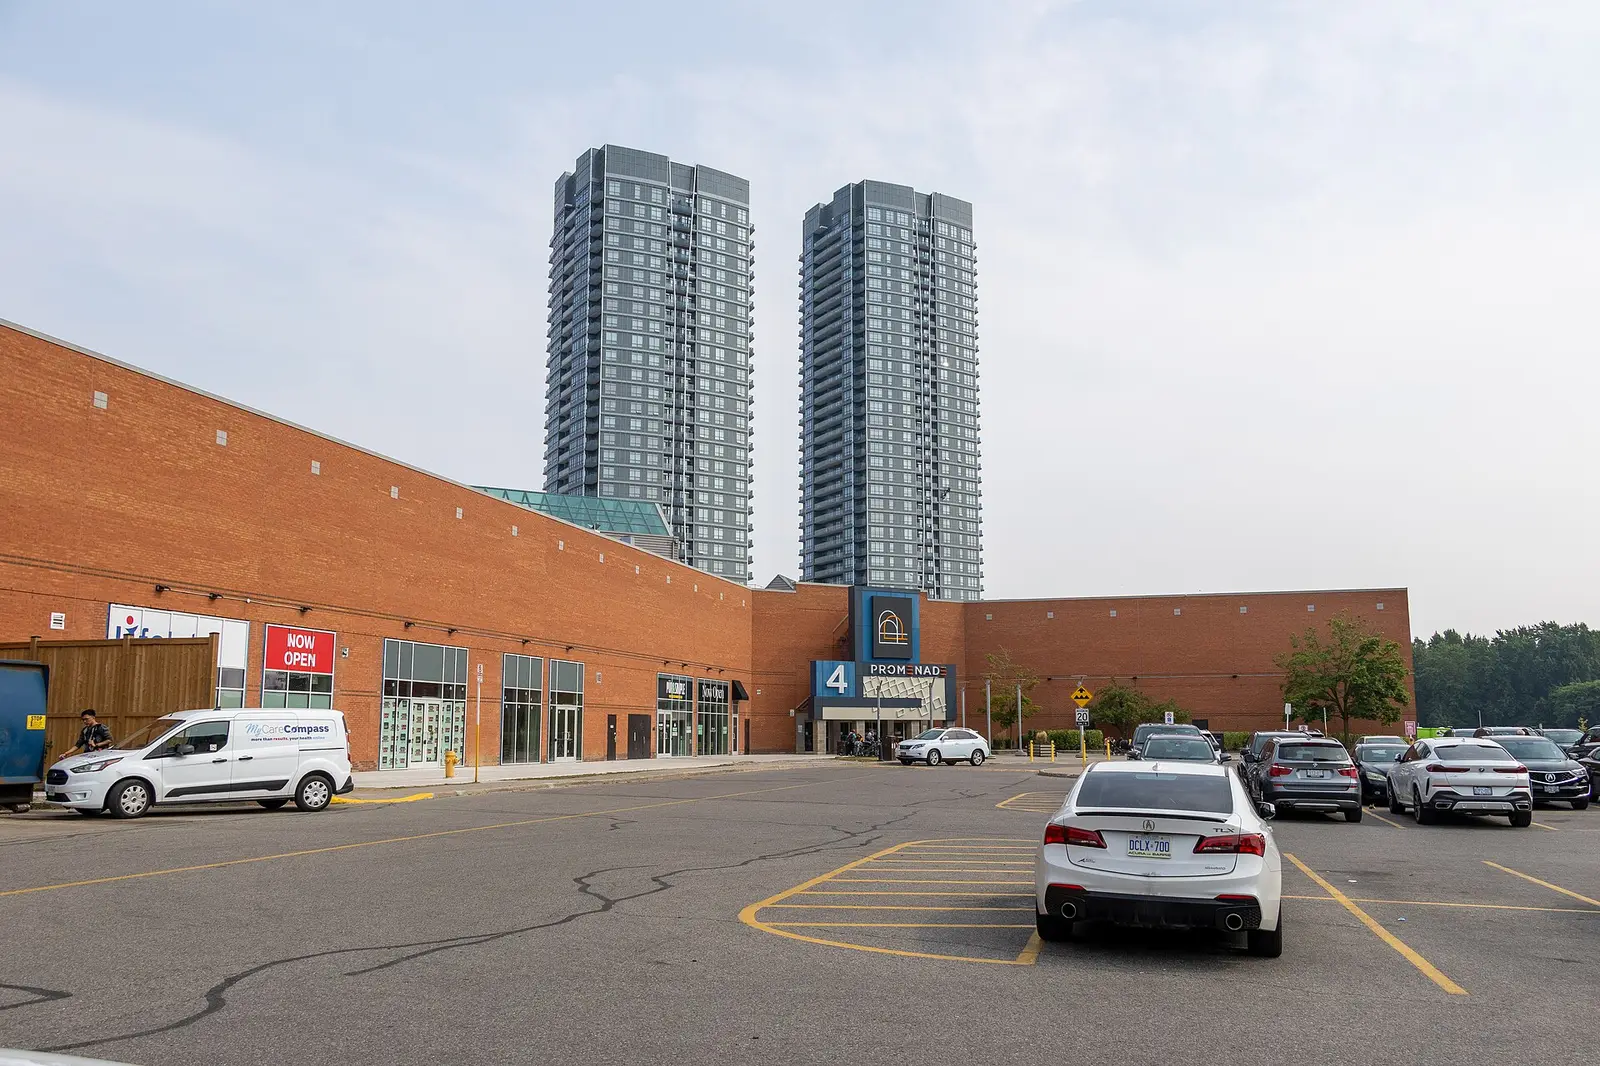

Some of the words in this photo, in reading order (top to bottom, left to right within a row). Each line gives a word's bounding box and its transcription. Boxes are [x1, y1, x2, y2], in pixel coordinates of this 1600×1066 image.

[287, 633, 315, 649] NOW
[284, 651, 316, 667] OPEN
[870, 664, 947, 676] PROMENADE
[826, 664, 848, 694] 4
[702, 685, 712, 698] Now
[712, 686, 724, 700] Open
[1077, 712, 1088, 721] 20
[245, 723, 329, 736] MyCareCompass
[1129, 839, 1150, 851] DCLX
[1154, 841, 1170, 852] 700
